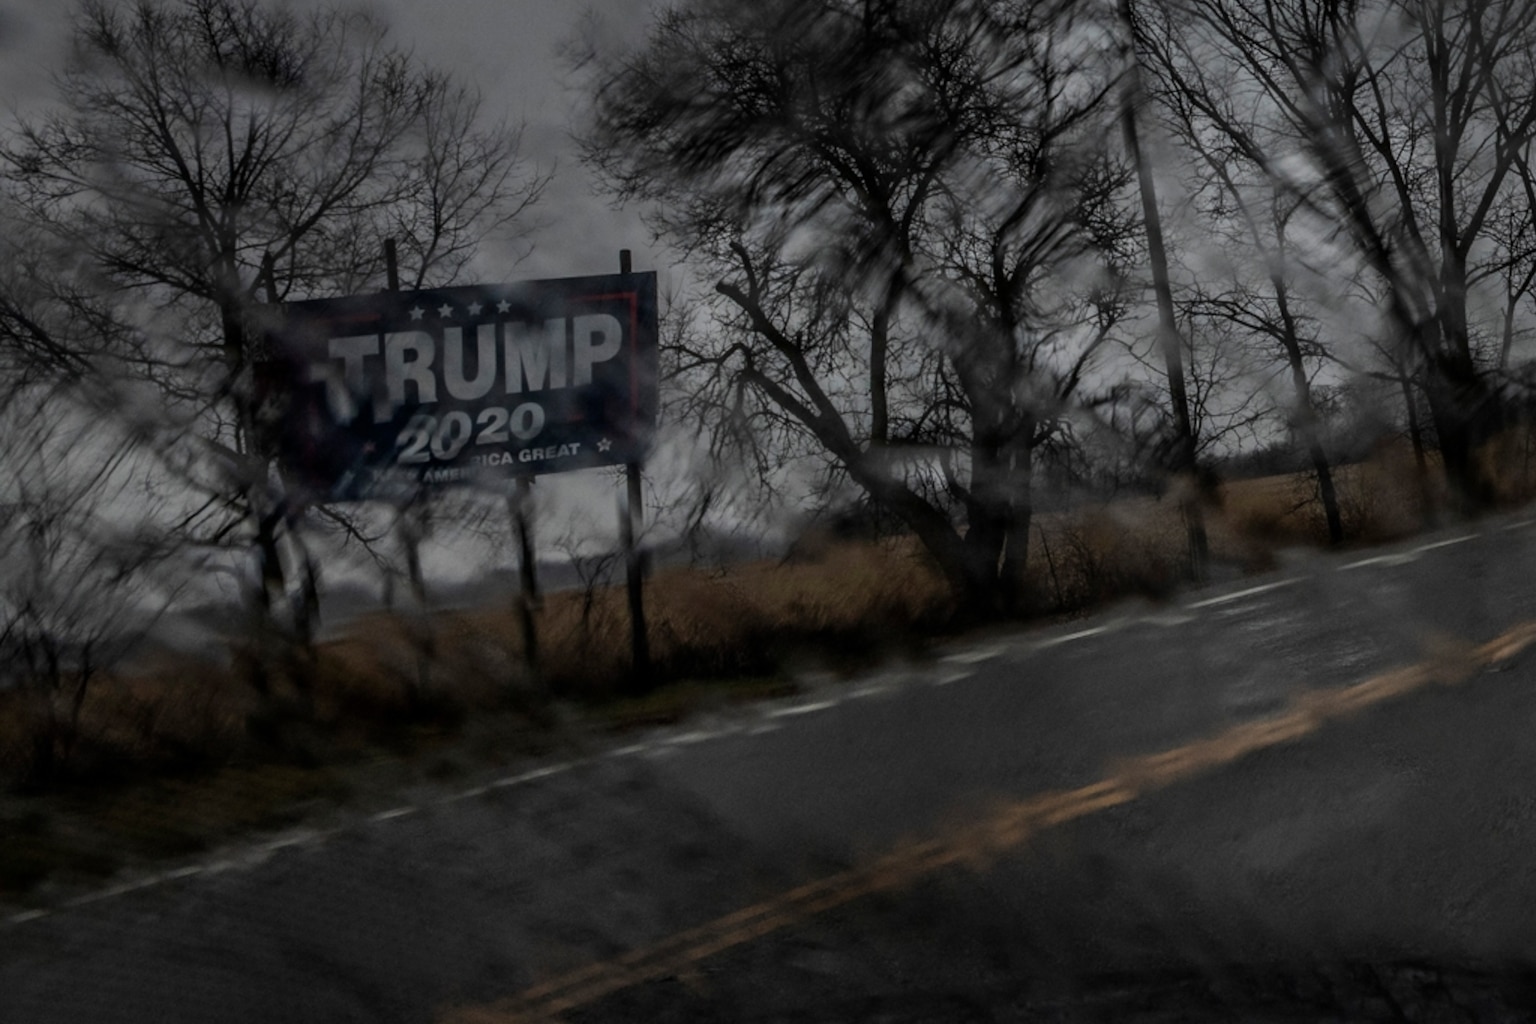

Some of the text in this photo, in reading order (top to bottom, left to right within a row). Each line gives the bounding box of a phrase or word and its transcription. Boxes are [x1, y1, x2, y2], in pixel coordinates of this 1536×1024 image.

[309, 312, 623, 427] TRUMP
[395, 401, 546, 465] 2020
[517, 441, 582, 464] GREAT
